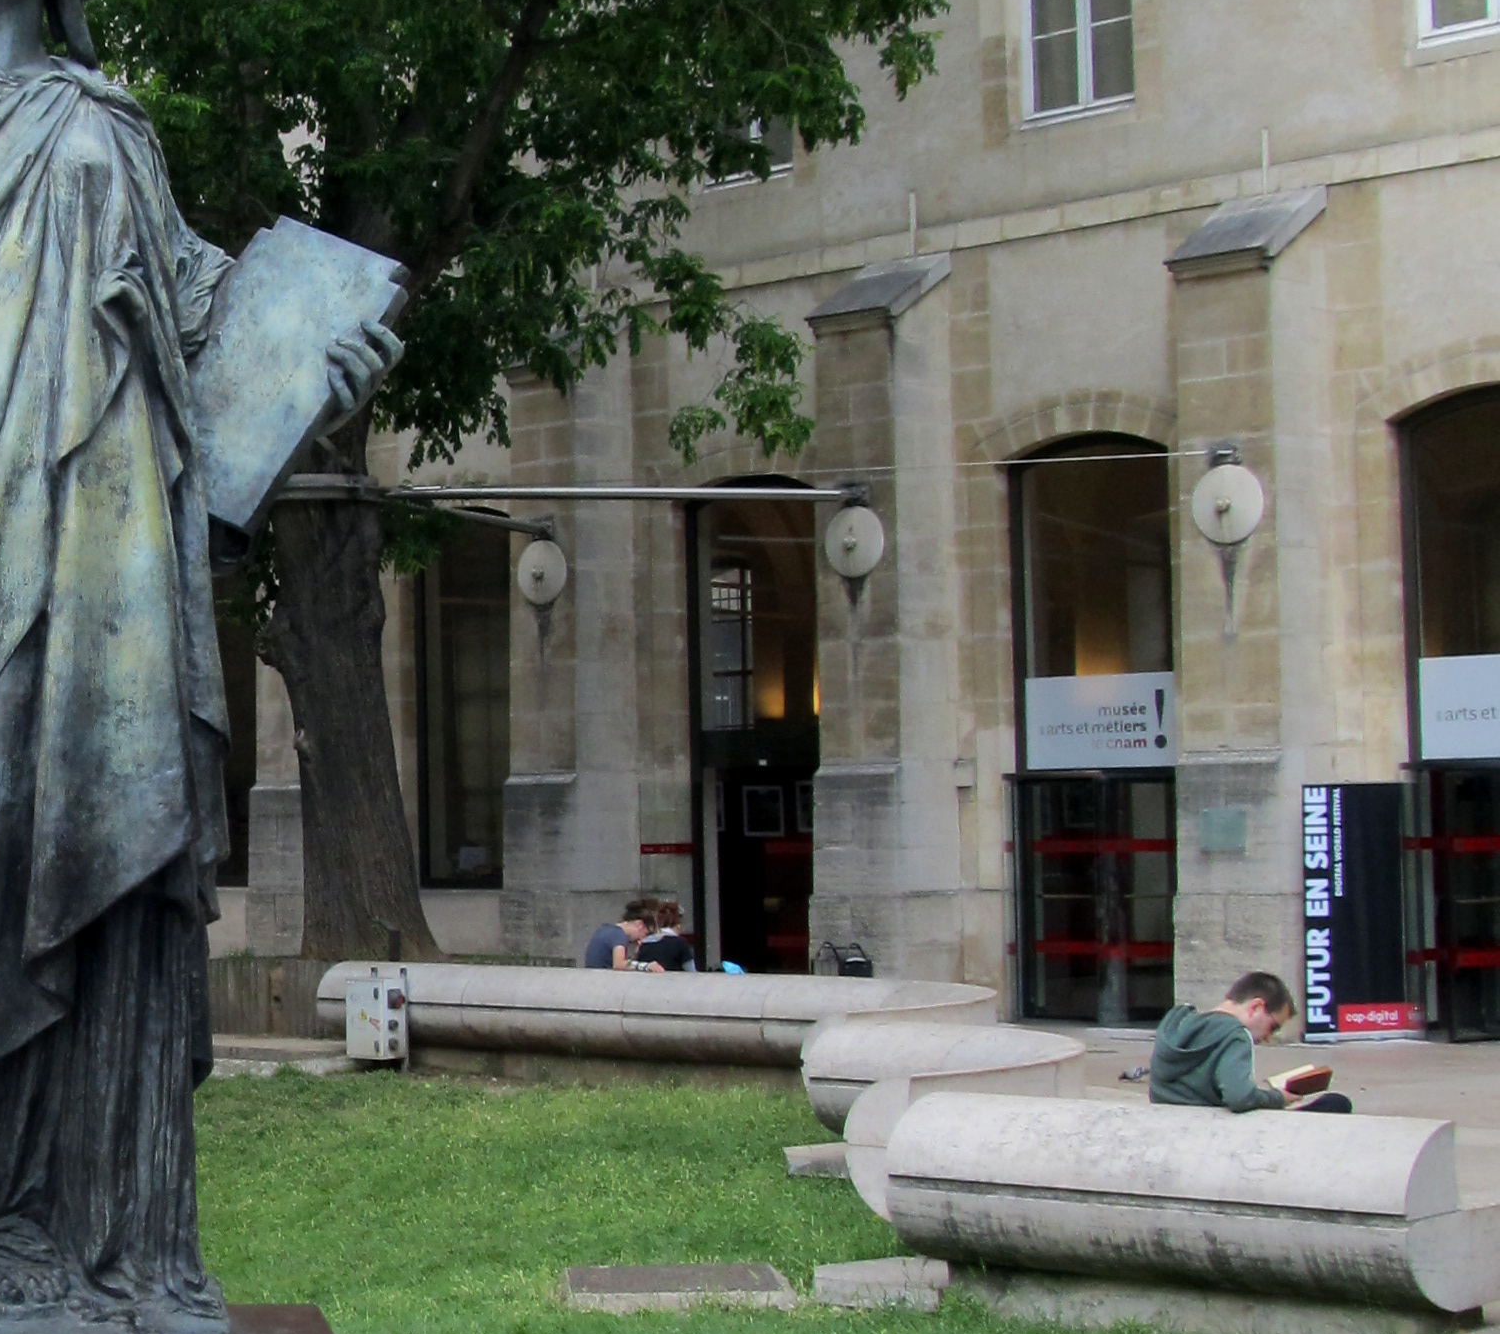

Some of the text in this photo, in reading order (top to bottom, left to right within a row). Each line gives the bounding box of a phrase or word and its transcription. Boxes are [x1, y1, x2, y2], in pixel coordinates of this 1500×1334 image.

[1099, 702, 1147, 716] musée
[1446, 708, 1477, 722] arts
[1481, 706, 1497, 720] et
[1046, 723, 1076, 736] arts
[1076, 721, 1090, 735] et
[1092, 719, 1147, 734] métiers
[1106, 737, 1147, 749] cnam
[1303, 787, 1329, 870] SEINE
[1332, 787, 1344, 897] DIGITAL WORLD FESTIVAL
[1305, 878, 1330, 917] EN
